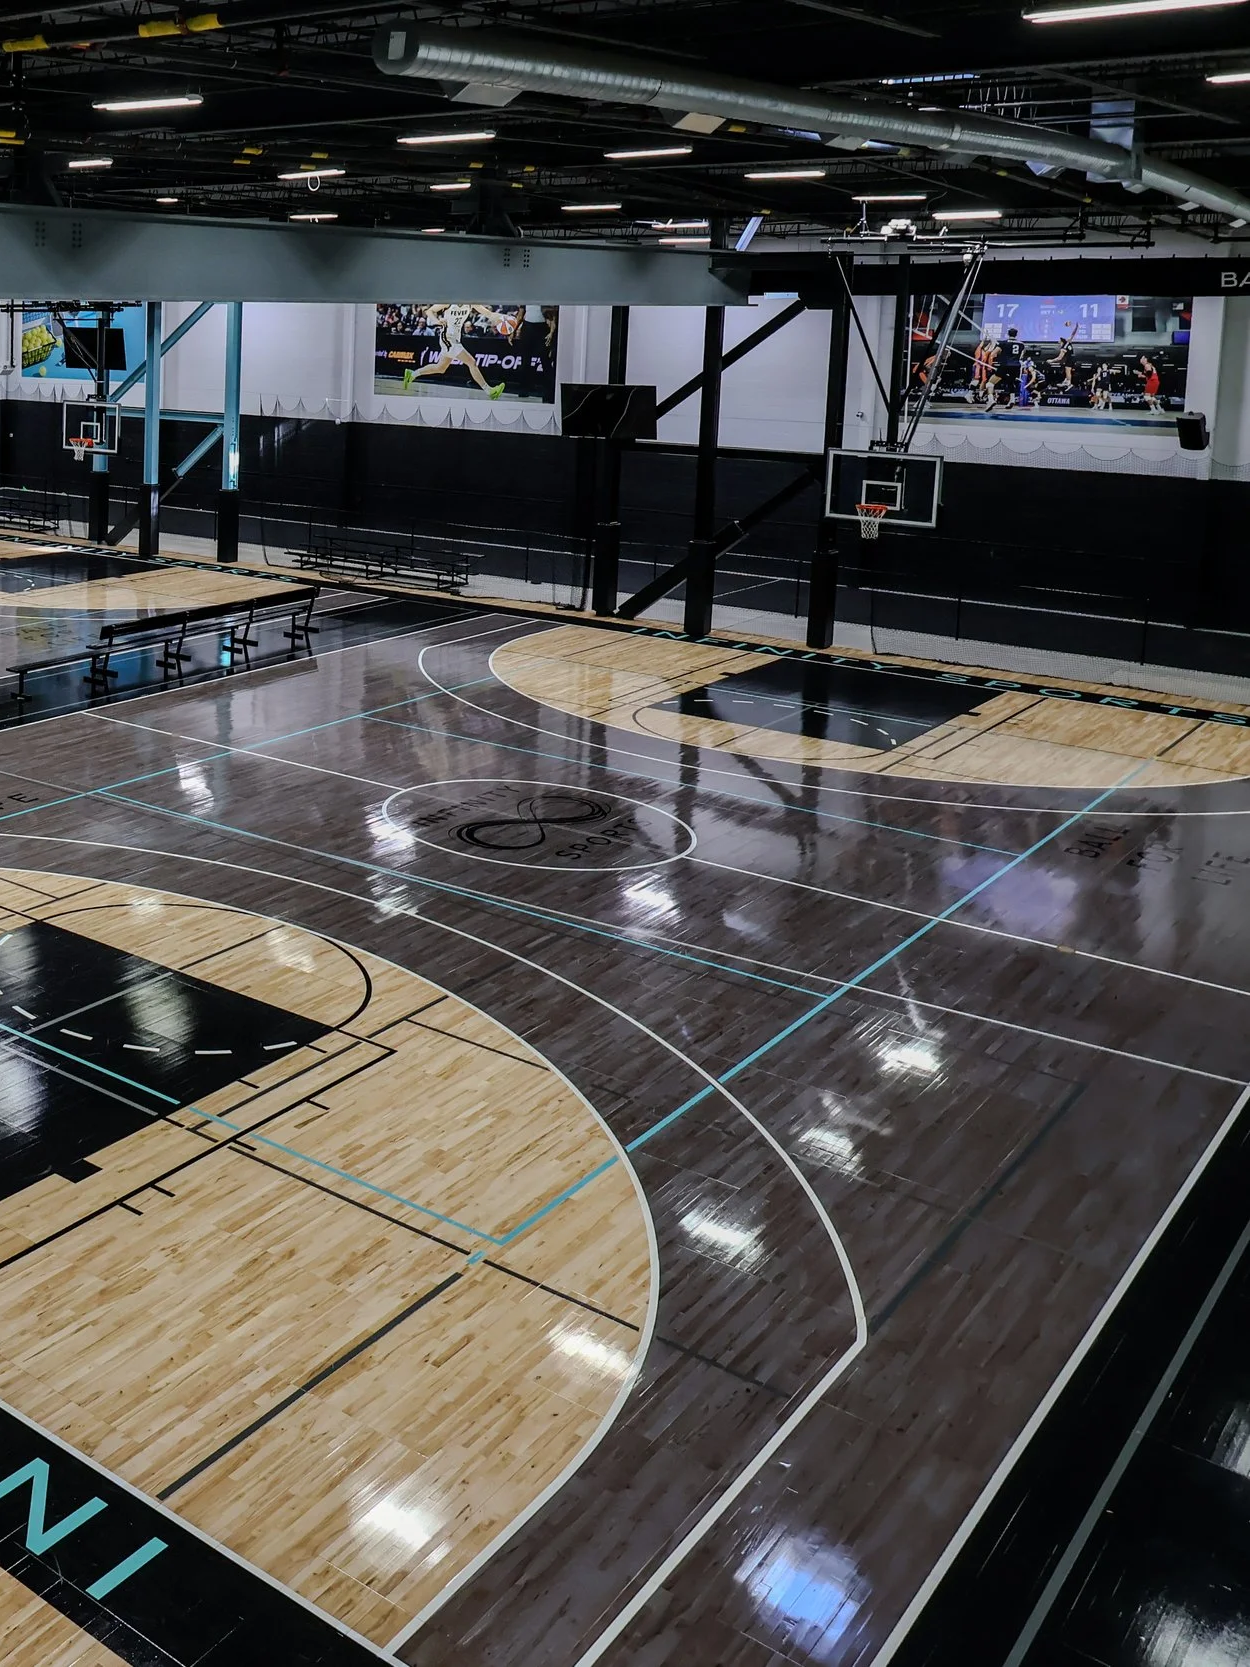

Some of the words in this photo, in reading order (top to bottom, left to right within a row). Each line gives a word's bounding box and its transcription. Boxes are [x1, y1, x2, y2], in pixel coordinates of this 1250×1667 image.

[997, 303, 1019, 318] 17
[1080, 303, 1099, 318] 11
[1012, 344, 1020, 354] 2
[1047, 396, 1071, 405] OTTAWA
[148, 556, 299, 582] SPORTS
[631, 627, 903, 670] INFINITY
[935, 672, 1249, 724] SPORTS
[1064, 826, 1130, 858] BALL
